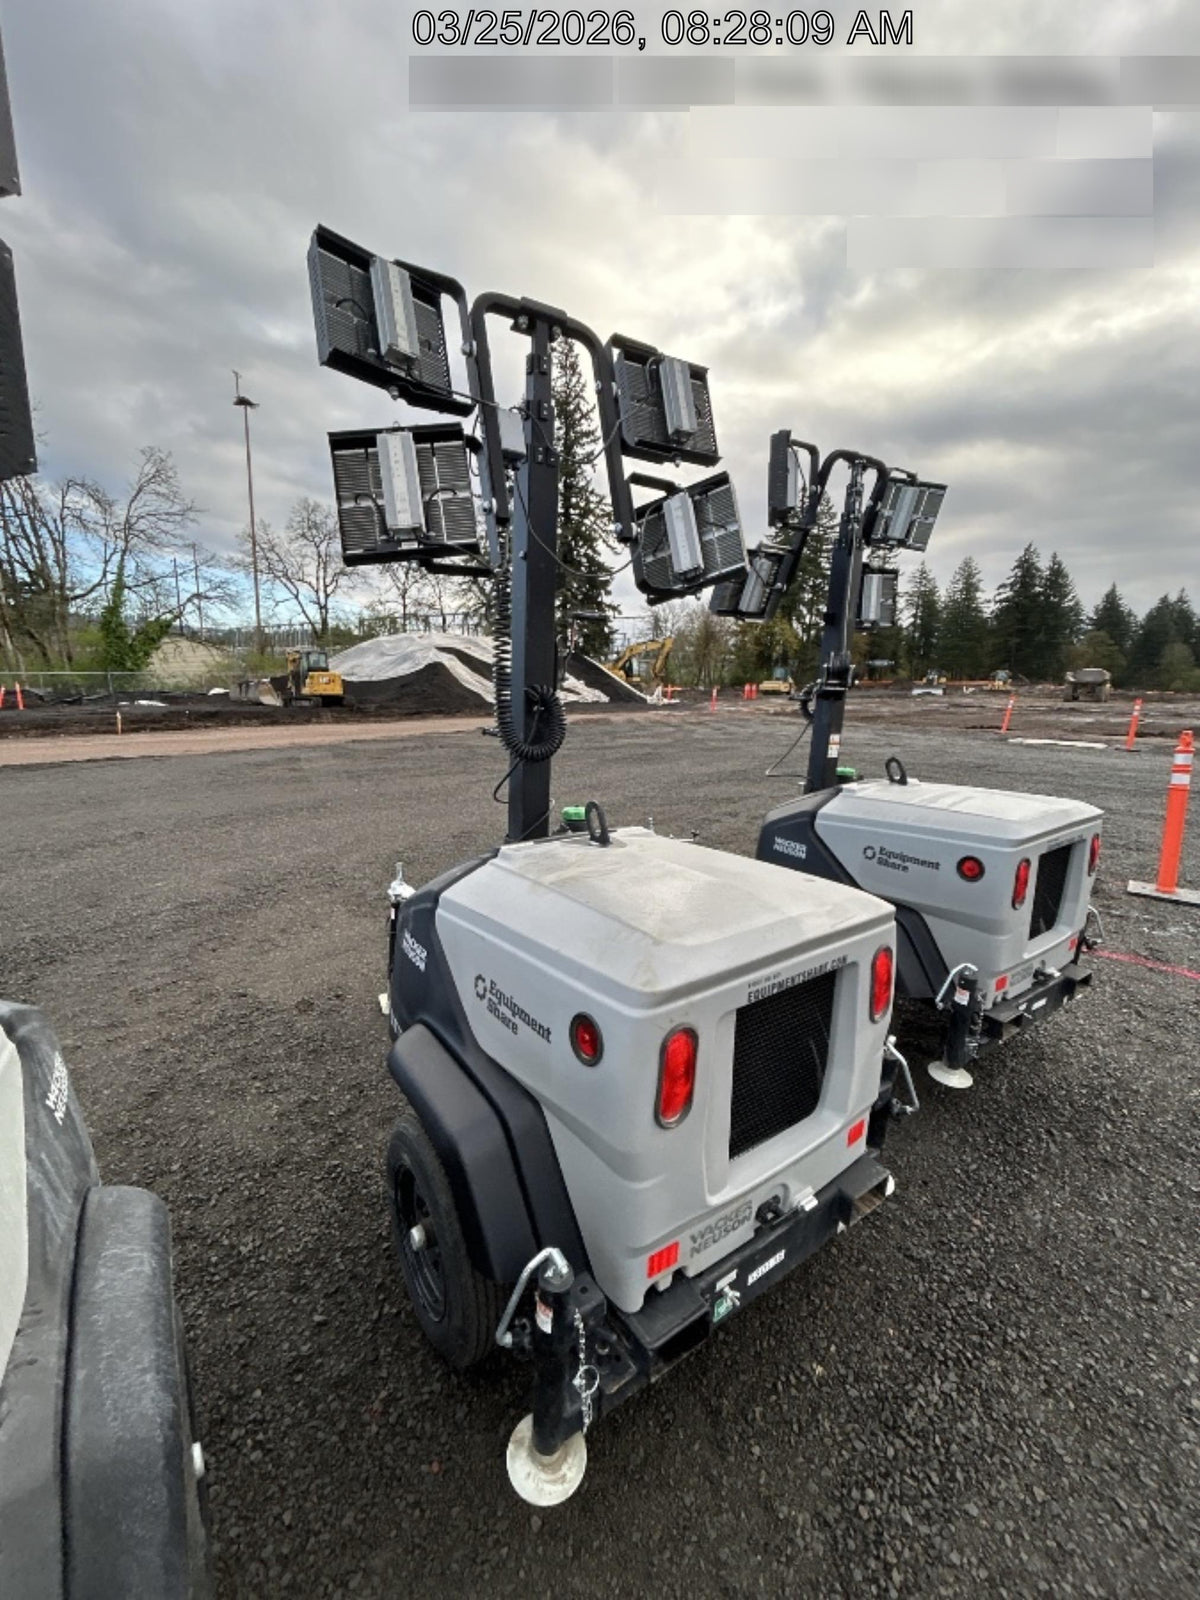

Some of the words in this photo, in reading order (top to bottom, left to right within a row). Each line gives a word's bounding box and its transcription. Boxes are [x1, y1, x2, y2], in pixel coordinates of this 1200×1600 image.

[876, 856, 910, 873] Share
[878, 845, 941, 871] Equipment
[486, 998, 519, 1036] Share
[488, 979, 552, 1044] Equipment
[690, 1213, 752, 1258] NEUSON
